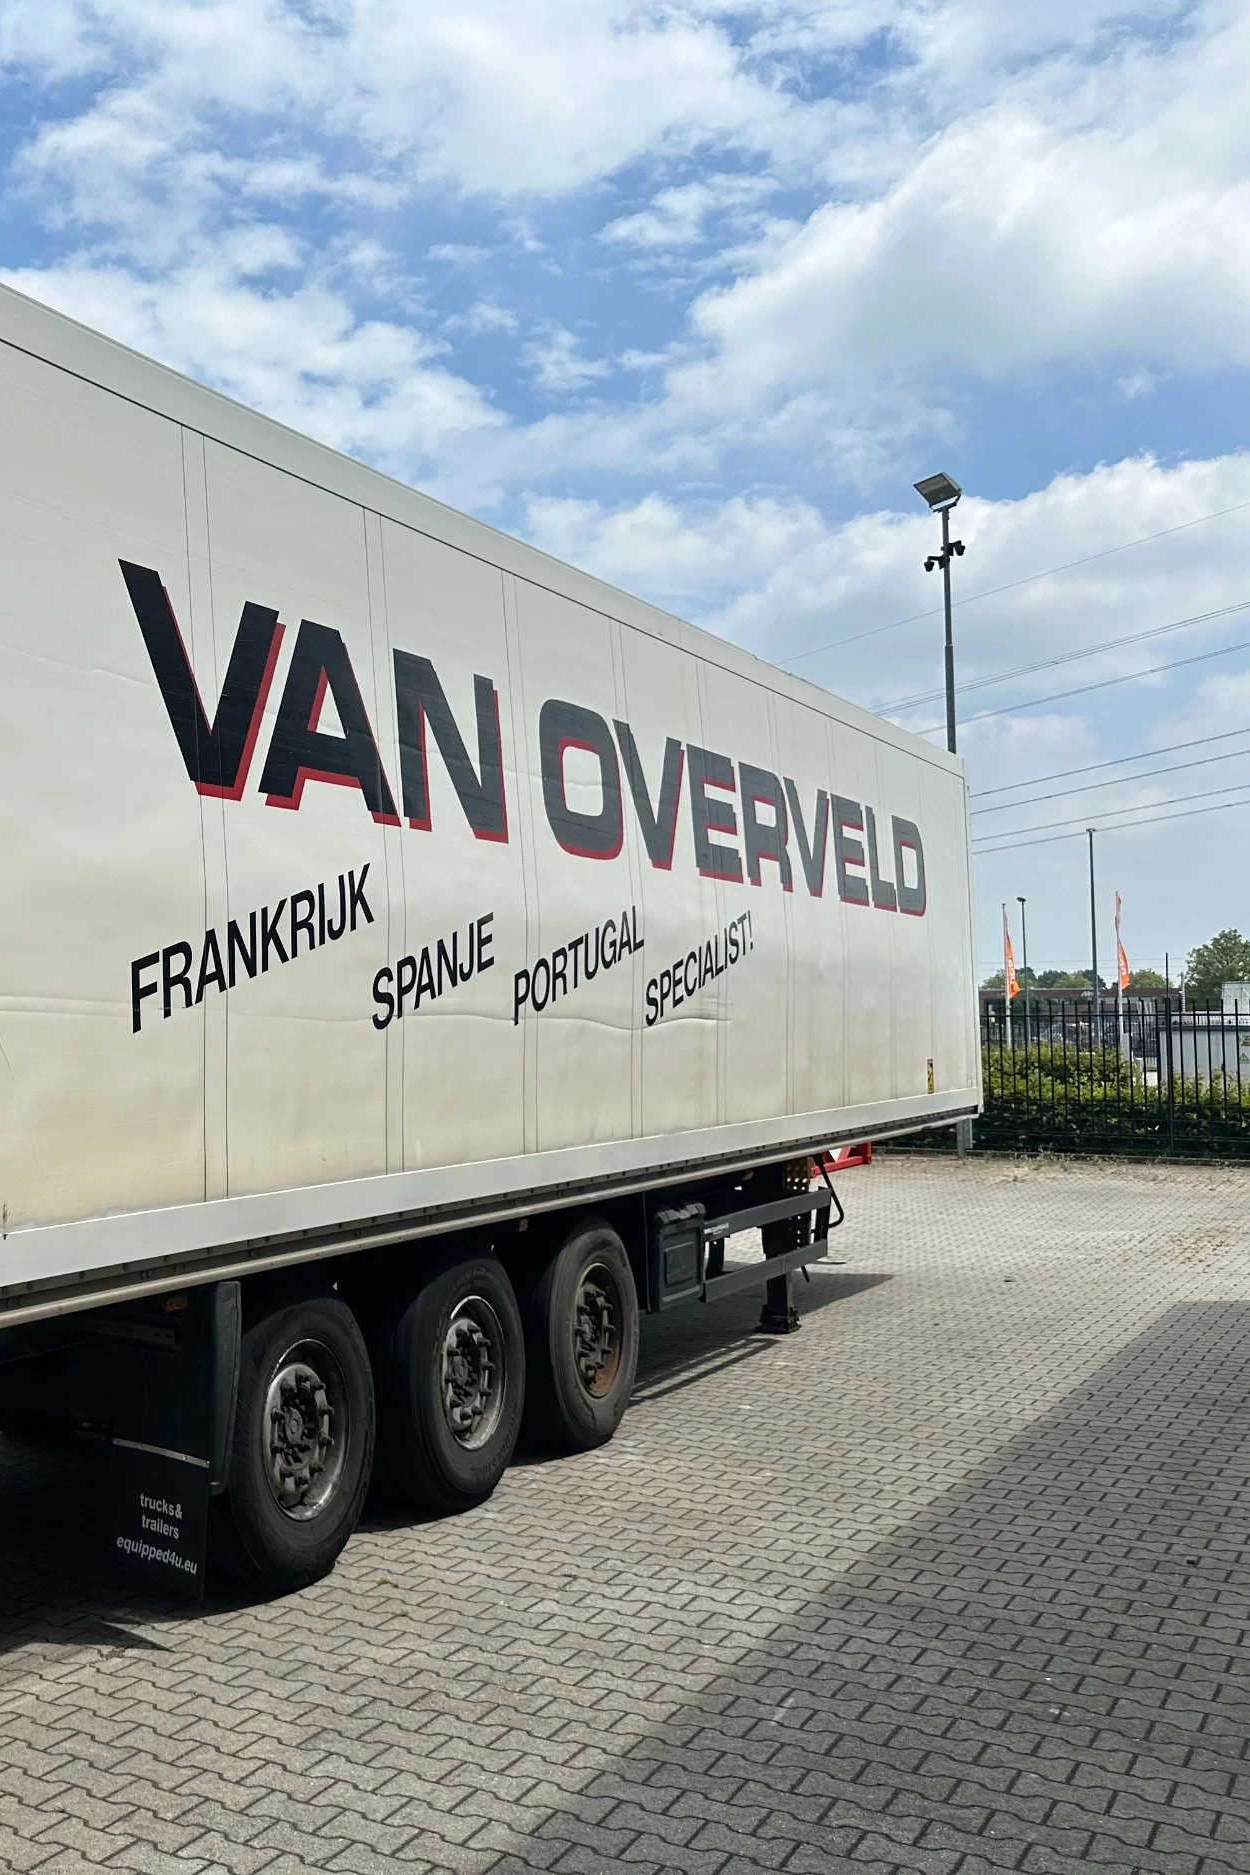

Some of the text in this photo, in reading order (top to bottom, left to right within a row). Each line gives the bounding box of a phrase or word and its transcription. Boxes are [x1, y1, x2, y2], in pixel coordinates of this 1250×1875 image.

[117, 558, 928, 917] VAN OVERVELD
[127, 862, 755, 1034] FRANKRIJK SPANJE PORTUGAL SPECIALIST!
[116, 1536, 198, 1575] equipped4u.eu
[141, 1513, 180, 1540] trailers
